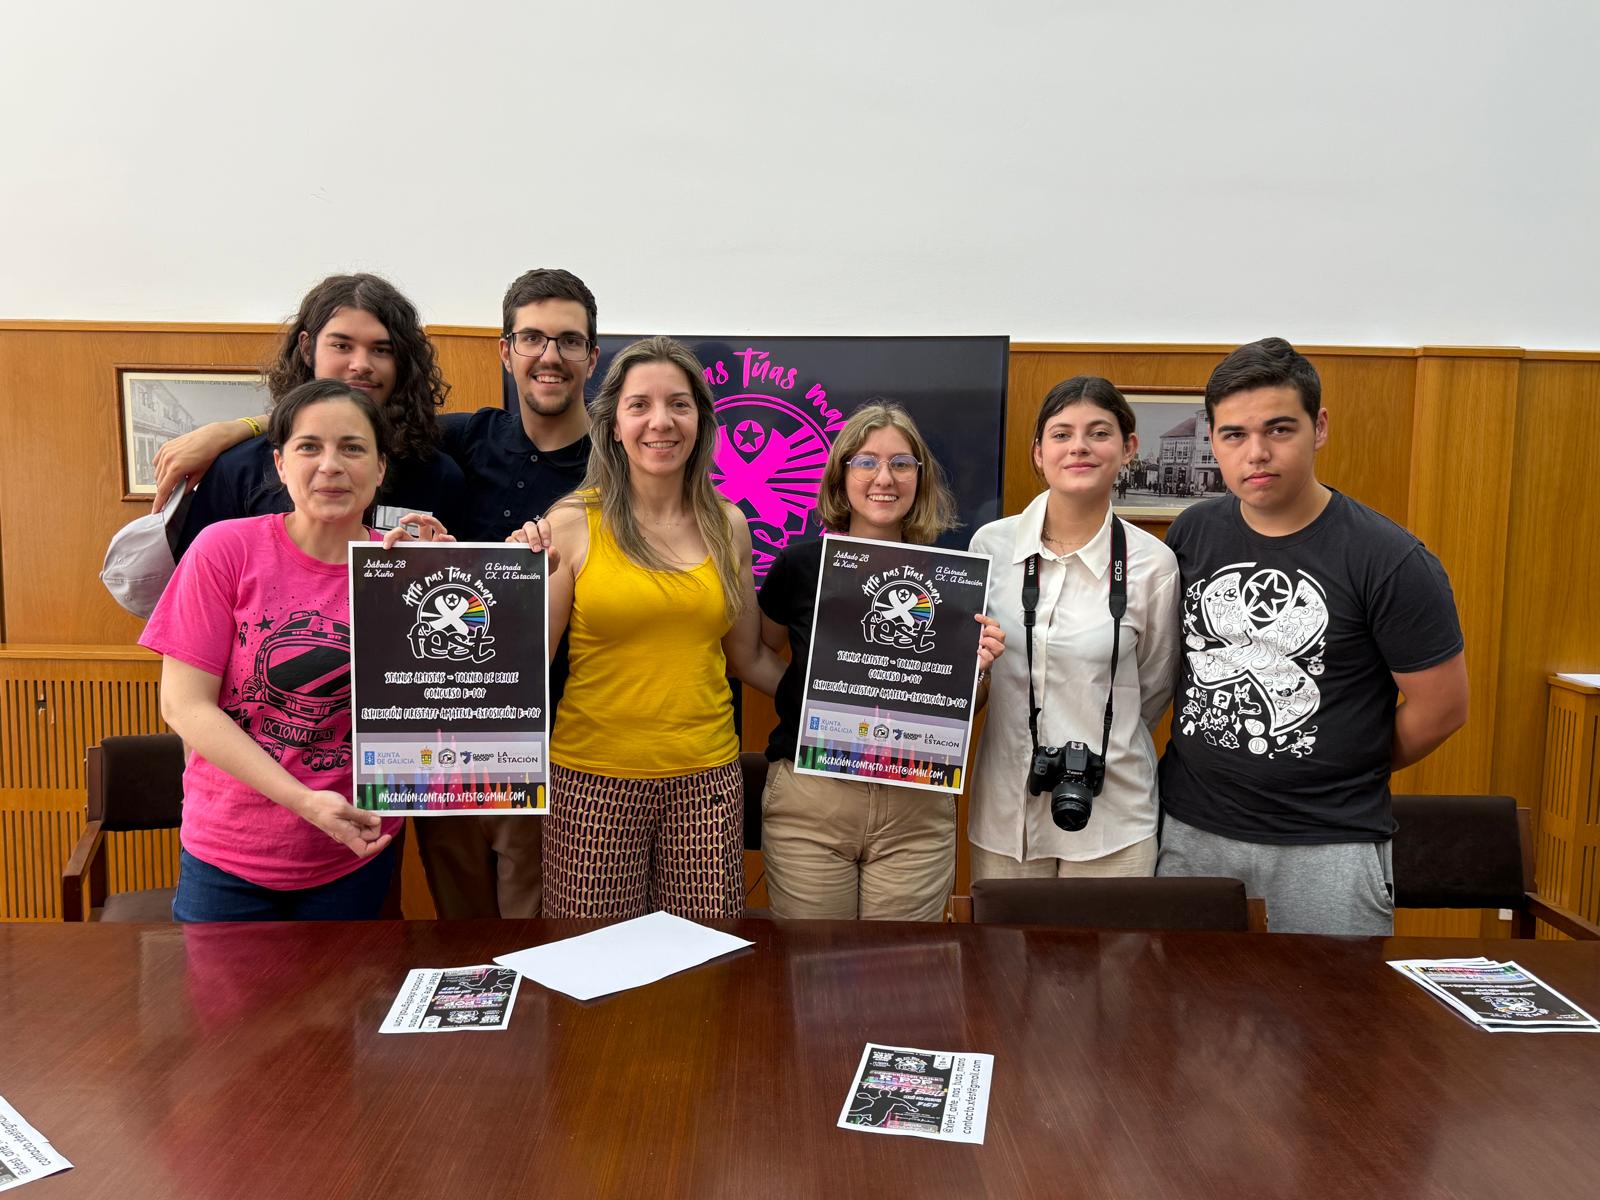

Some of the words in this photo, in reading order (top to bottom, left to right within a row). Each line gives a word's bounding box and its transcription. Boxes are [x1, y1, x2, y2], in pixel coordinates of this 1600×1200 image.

[703, 360, 729, 385] as
[733, 347, 798, 390] Túas
[833, 550, 859, 561] Sábado
[858, 553, 870, 563] 28
[363, 559, 394, 569] Sábado
[394, 560, 407, 569] 28
[485, 562, 493, 571] A
[493, 562, 522, 571] Estrada
[832, 559, 841, 567] de
[840, 560, 858, 570] Xuño
[363, 569, 373, 578] de
[373, 569, 395, 578] Xuño
[502, 571, 510, 580] A
[511, 571, 541, 580] Estación
[935, 566, 943, 574] A
[943, 567, 968, 577] Estrada
[1114, 560, 1123, 582] EOS
[949, 575, 958, 583] A
[957, 576, 983, 587] Estación
[837, 650, 862, 663] STANDS
[861, 653, 890, 667] ARTISTAS
[896, 657, 921, 671] TORNEO
[921, 661, 932, 673] DE
[384, 671, 414, 684] STANDS
[413, 671, 447, 684] ARTISTAS
[454, 671, 483, 684] TORNEO
[483, 672, 495, 684] DE
[868, 668, 901, 682] CONCURSO
[900, 673, 923, 685] K-POP
[812, 679, 849, 694] EXHIBICIÓN
[424, 687, 462, 700] CONCURSO
[462, 687, 487, 699] K-POP
[361, 705, 403, 720] EXHIBICIÓN
[517, 707, 541, 719] K-POP
[821, 719, 842, 727] XUNTA
[829, 725, 853, 734] GALICIA
[497, 756, 539, 764] ESTACIÓN
